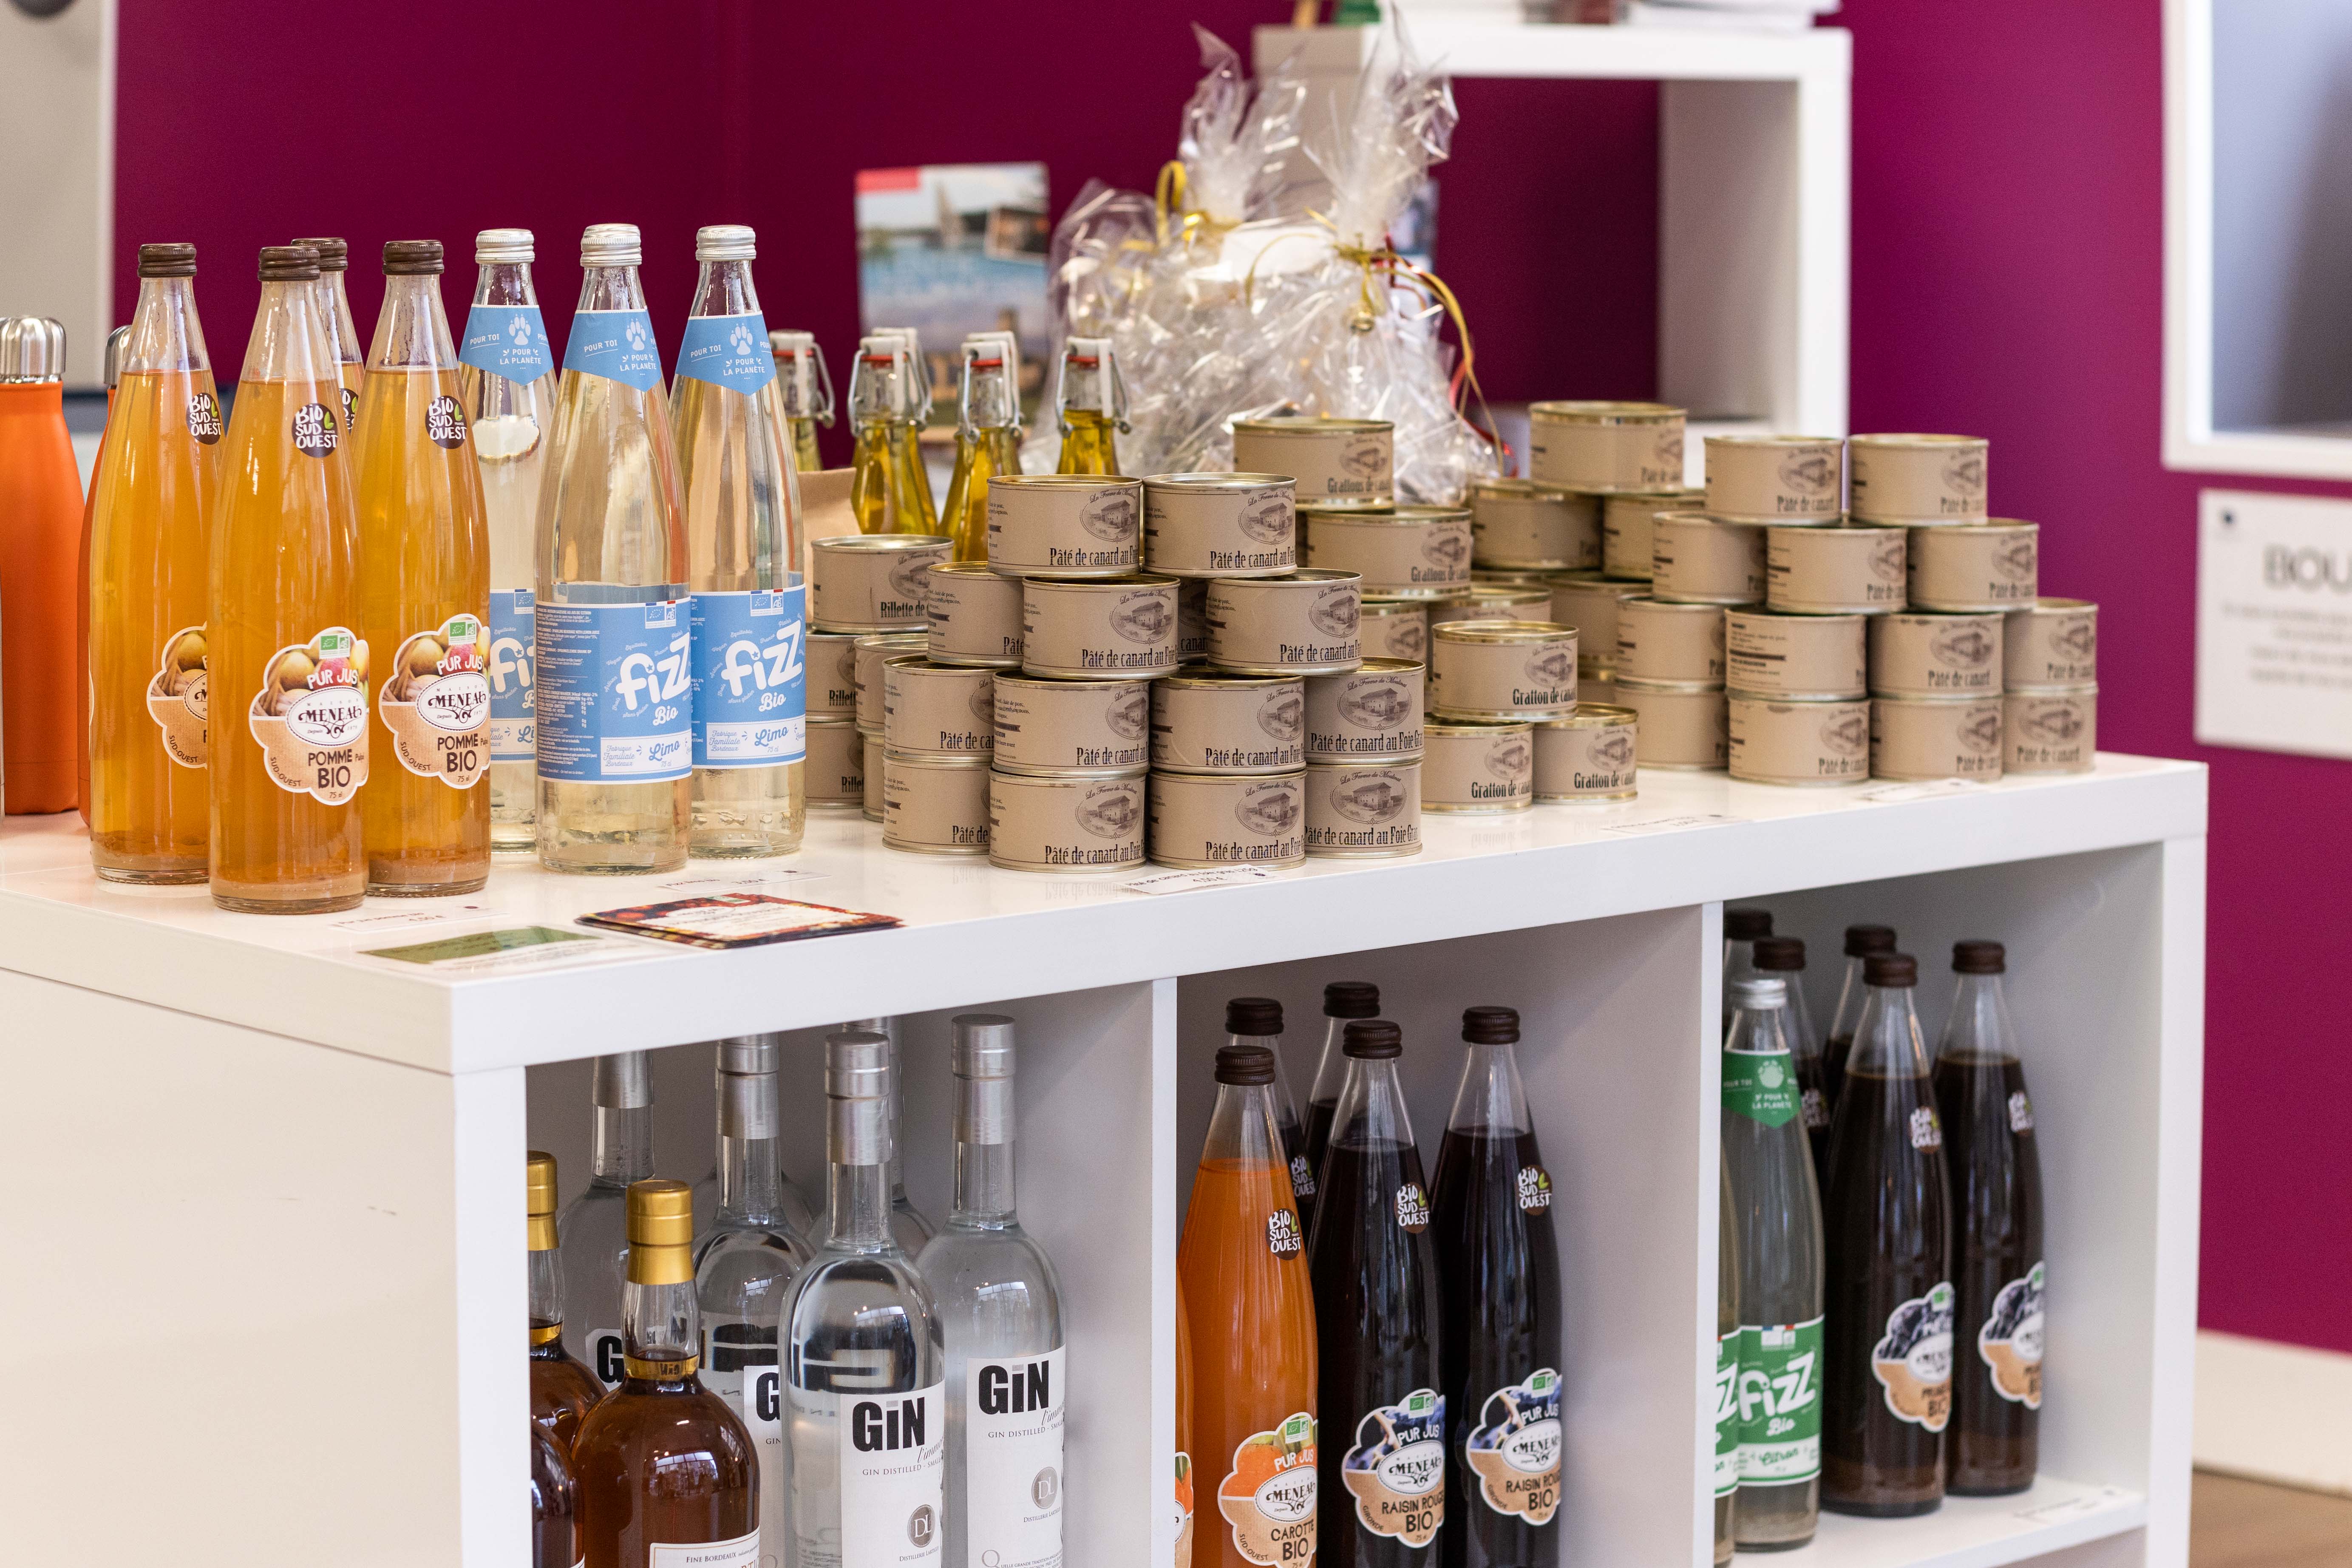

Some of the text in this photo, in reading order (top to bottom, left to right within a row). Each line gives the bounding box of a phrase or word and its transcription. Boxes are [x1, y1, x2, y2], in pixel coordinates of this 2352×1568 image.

[470, 335, 486, 345] POUR
[584, 340, 617, 352] POUR TOI
[690, 344, 722, 357] POUR TOI
[512, 356, 541, 364] PLANÈTE
[734, 366, 765, 374] PLANÈTE
[190, 411, 210, 424] SUD
[428, 415, 453, 427] SUD
[190, 422, 221, 437] OUEST
[295, 423, 322, 436] SUD
[429, 426, 468, 441] OUEST
[296, 434, 338, 449] OUEST
[1050, 547, 1129, 566] Pâté de canard au
[1210, 548, 1287, 569] Pâté de canard au
[880, 600, 927, 618] Rillette de
[1082, 646, 1164, 667] Pâté de canard au
[1279, 641, 1355, 663] Pâté de canard au
[436, 655, 483, 675] PUR JUS
[306, 667, 359, 689] PUR JUS
[758, 692, 786, 712] Bio
[829, 689, 856, 706] Rillett
[1513, 686, 1559, 706] Gratton de
[652, 705, 679, 726] Bio
[437, 733, 479, 751] POMME
[708, 737, 741, 746] Familiale
[712, 730, 737, 738] Fabrique
[754, 725, 789, 748] Limo
[940, 731, 978, 749] Pâté de
[1310, 731, 1414, 752] Pâté de canard au Foie
[308, 748, 352, 766] POMME
[606, 744, 632, 753] Fabrique
[649, 740, 680, 762] Limo
[1077, 745, 1139, 766] Pâté de canard
[1206, 745, 1289, 766] Pâté de canard au
[447, 750, 476, 773] BIO
[317, 765, 351, 789] BIO
[842, 776, 864, 793] Rillet
[1340, 775, 1351, 785] La
[1352, 771, 1371, 780] Ferme
[1574, 770, 1619, 789] Gratton de
[1471, 779, 1516, 799] Gratton de
[952, 825, 988, 843] Pâté de
[1304, 825, 1407, 846] Pâté de canard au Foie
[1044, 843, 1130, 864] Pâté de canard au
[1205, 840, 1289, 860] Pâté de canard au
[1397, 1202, 1418, 1215] SUD
[1519, 1193, 1552, 1209] OUEST
[1398, 1211, 1429, 1226] OUEST
[1269, 1229, 1290, 1241] SUD
[1271, 1237, 1301, 1253] OUEST
[1521, 1406, 1542, 1425] PUR
[1009, 1427, 1045, 1438] DISTILLED
[1397, 1424, 1440, 1446] PUR JUS
[883, 1463, 922, 1475] DISTILLED
[1274, 1449, 1314, 1472] PUR JUS
[1038, 1476, 1055, 1500] DL
[1506, 1477, 1541, 1493] RAISIN
[1382, 1500, 1419, 1514] RAISIN
[1528, 1489, 1553, 1511] BIO
[914, 1514, 932, 1538] DL
[1271, 1519, 1315, 1541] CAROTTE
[1406, 1511, 1434, 1533] BIO
[705, 1552, 737, 1562] BORDEAUX
[1282, 1537, 1309, 1561] BIO
